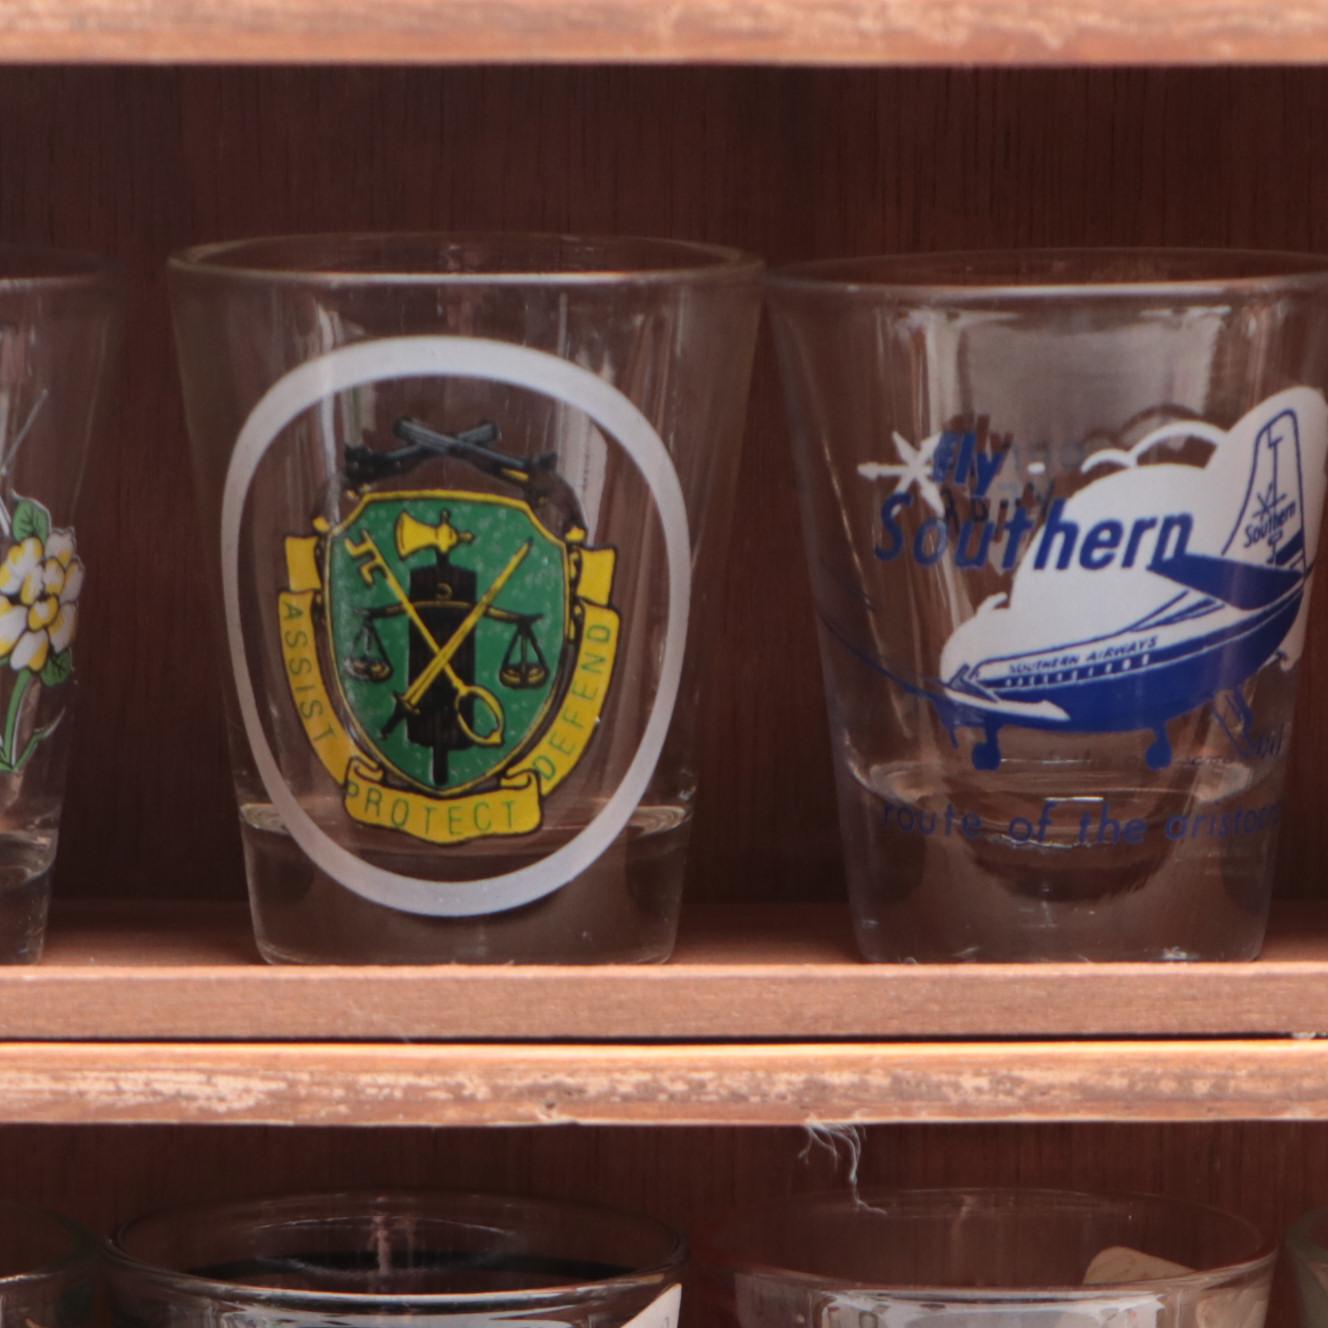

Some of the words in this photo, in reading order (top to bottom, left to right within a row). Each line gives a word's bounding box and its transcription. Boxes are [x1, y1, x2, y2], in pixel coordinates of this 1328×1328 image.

[933, 431, 1008, 498] Fly
[875, 490, 1193, 573] Southern
[281, 600, 337, 748] ASSIST
[532, 620, 612, 783] DEFEND
[346, 781, 519, 838] PROTECT
[1007, 800, 1057, 844] of
[1077, 801, 1147, 844] the
